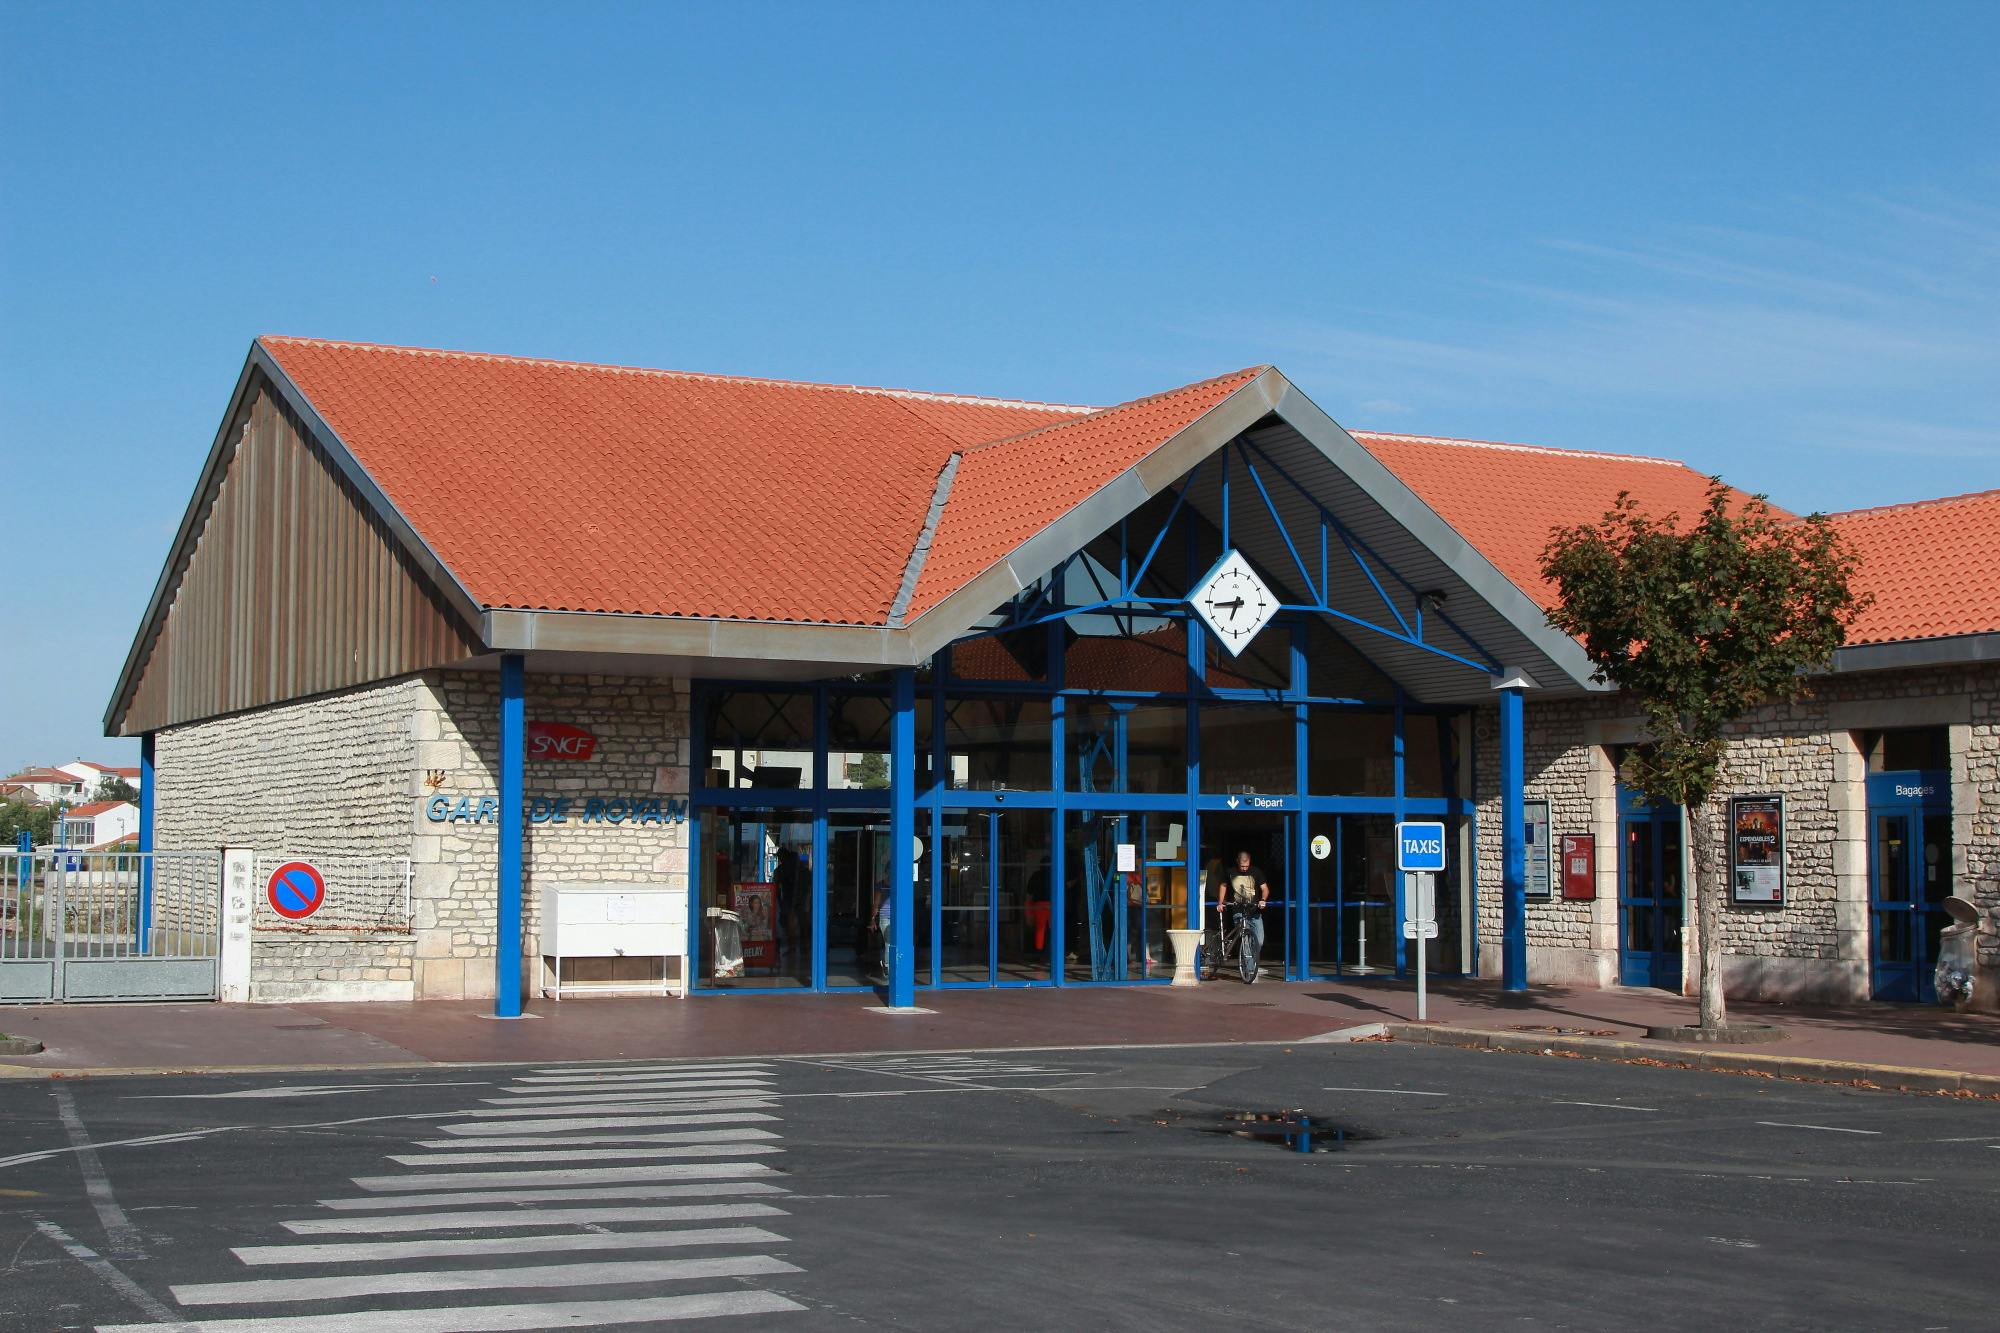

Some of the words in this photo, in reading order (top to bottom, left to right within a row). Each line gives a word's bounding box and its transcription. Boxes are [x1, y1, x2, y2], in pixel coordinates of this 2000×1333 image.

[532, 736, 593, 754] SNCF
[1895, 785, 1936, 797] Bagages
[1254, 797, 1283, 808] Départ
[426, 795, 500, 823] GAR
[529, 798, 571, 824] DE
[582, 798, 689, 825] ROYAN
[1403, 839, 1441, 854] TAXIS
[743, 946, 764, 957] RELAY
